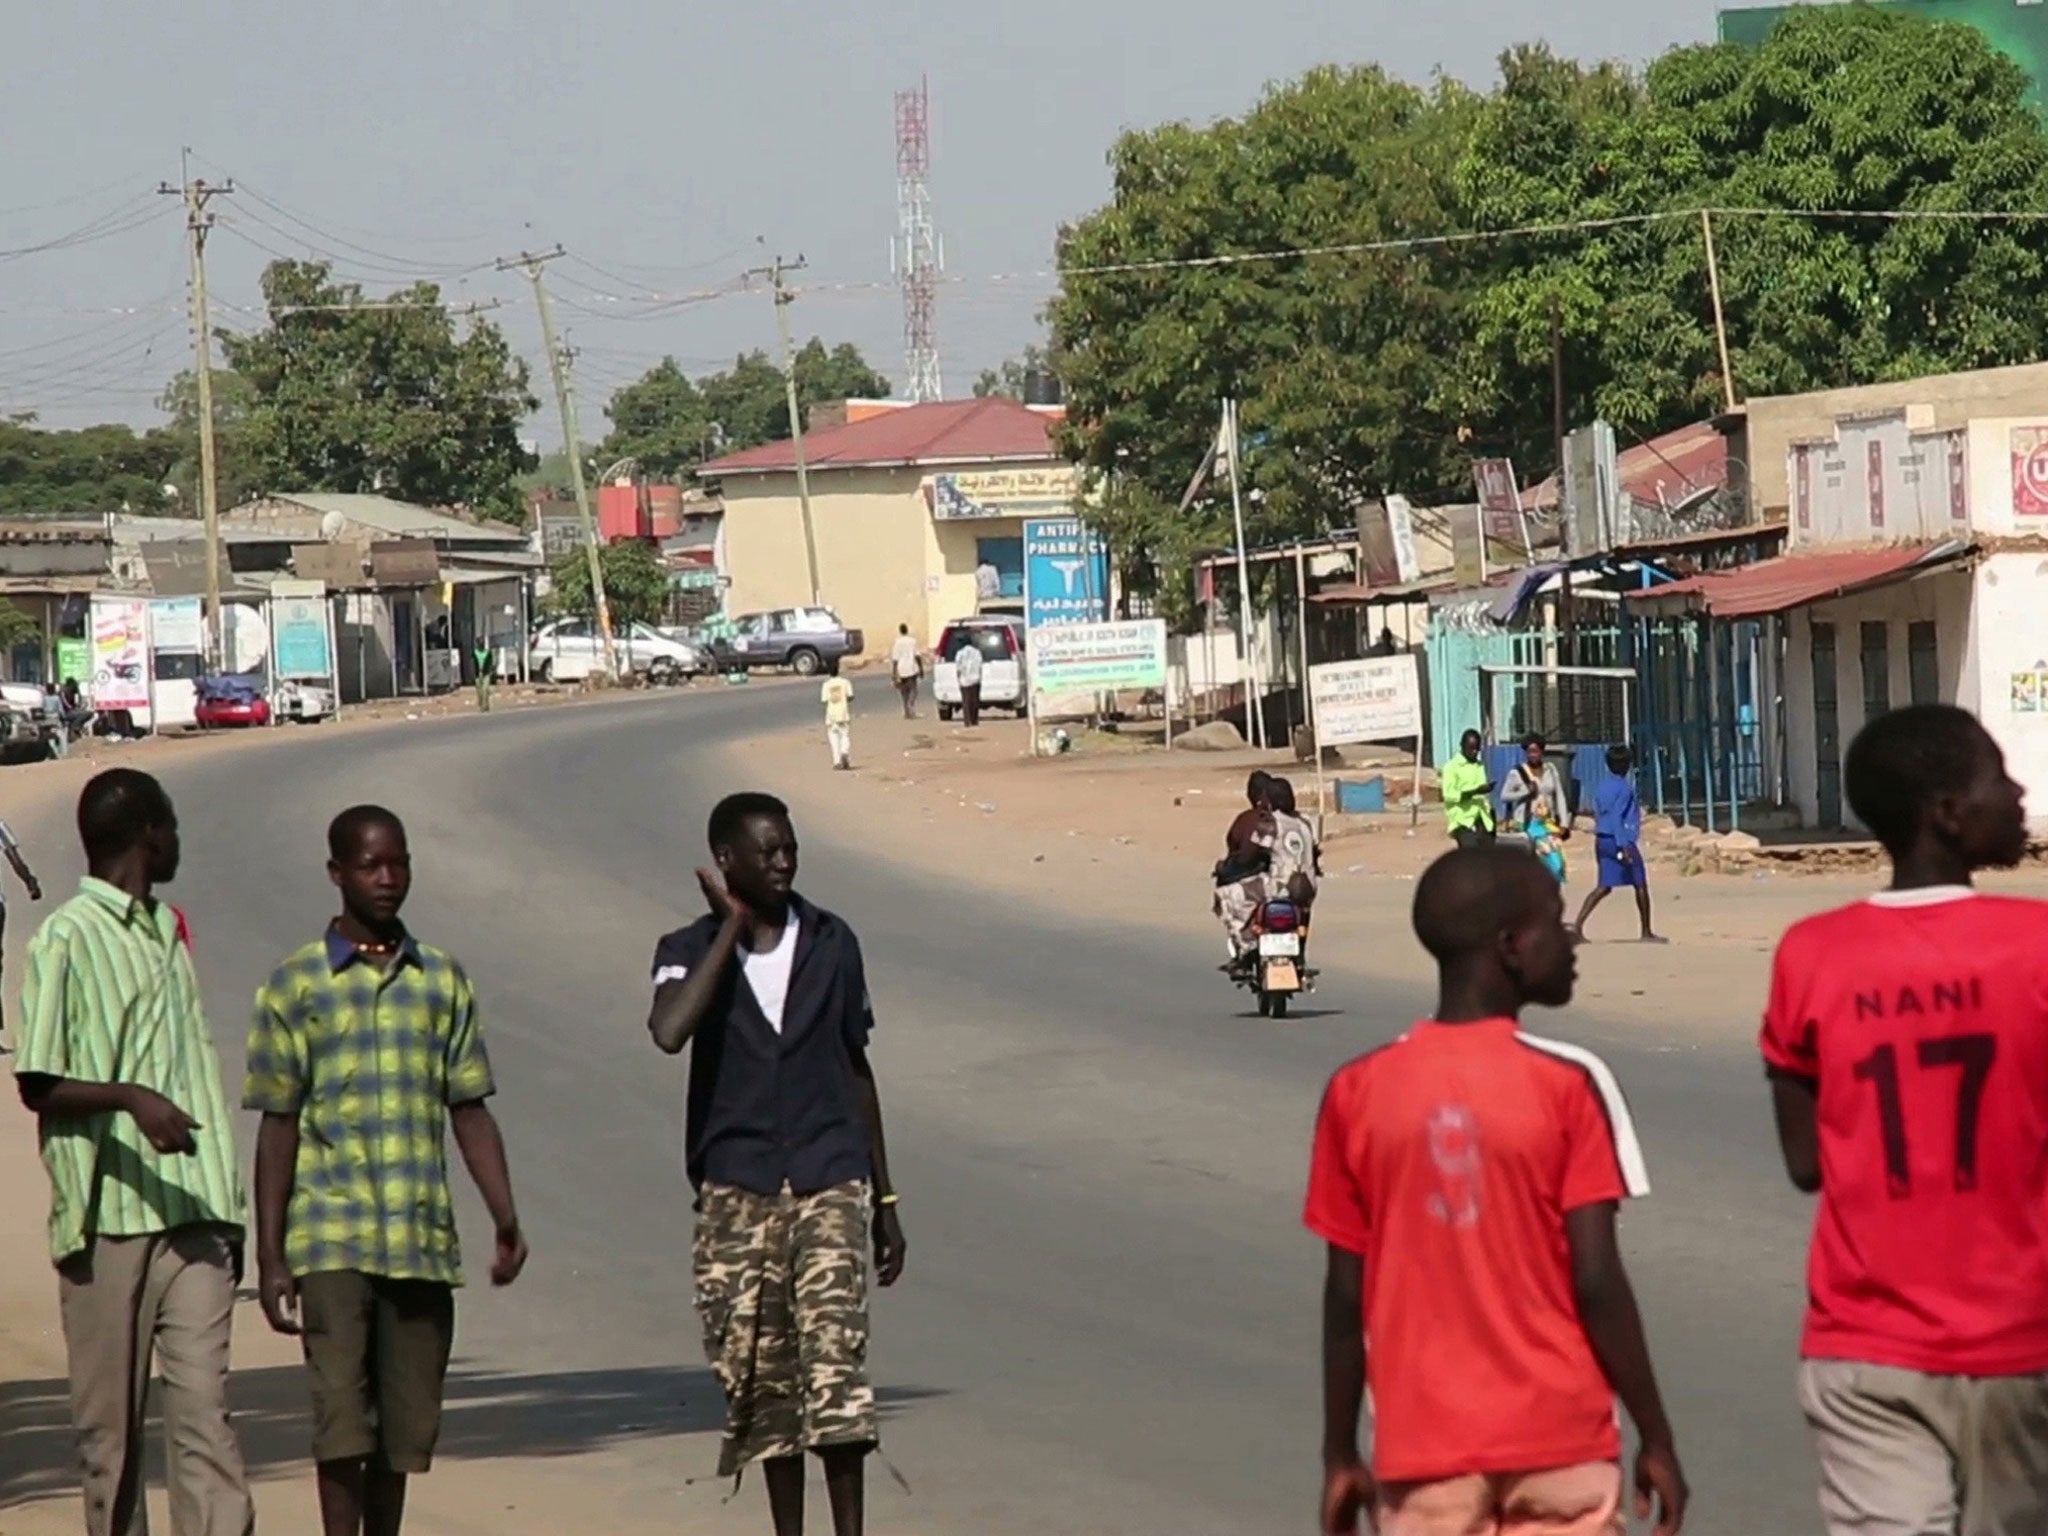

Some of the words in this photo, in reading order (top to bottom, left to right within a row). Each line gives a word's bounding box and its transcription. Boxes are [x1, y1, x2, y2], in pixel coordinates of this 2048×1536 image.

[1855, 977, 1982, 1021] NANI
[1426, 1102, 1483, 1228] 9
[1852, 1032, 1997, 1199] 17
